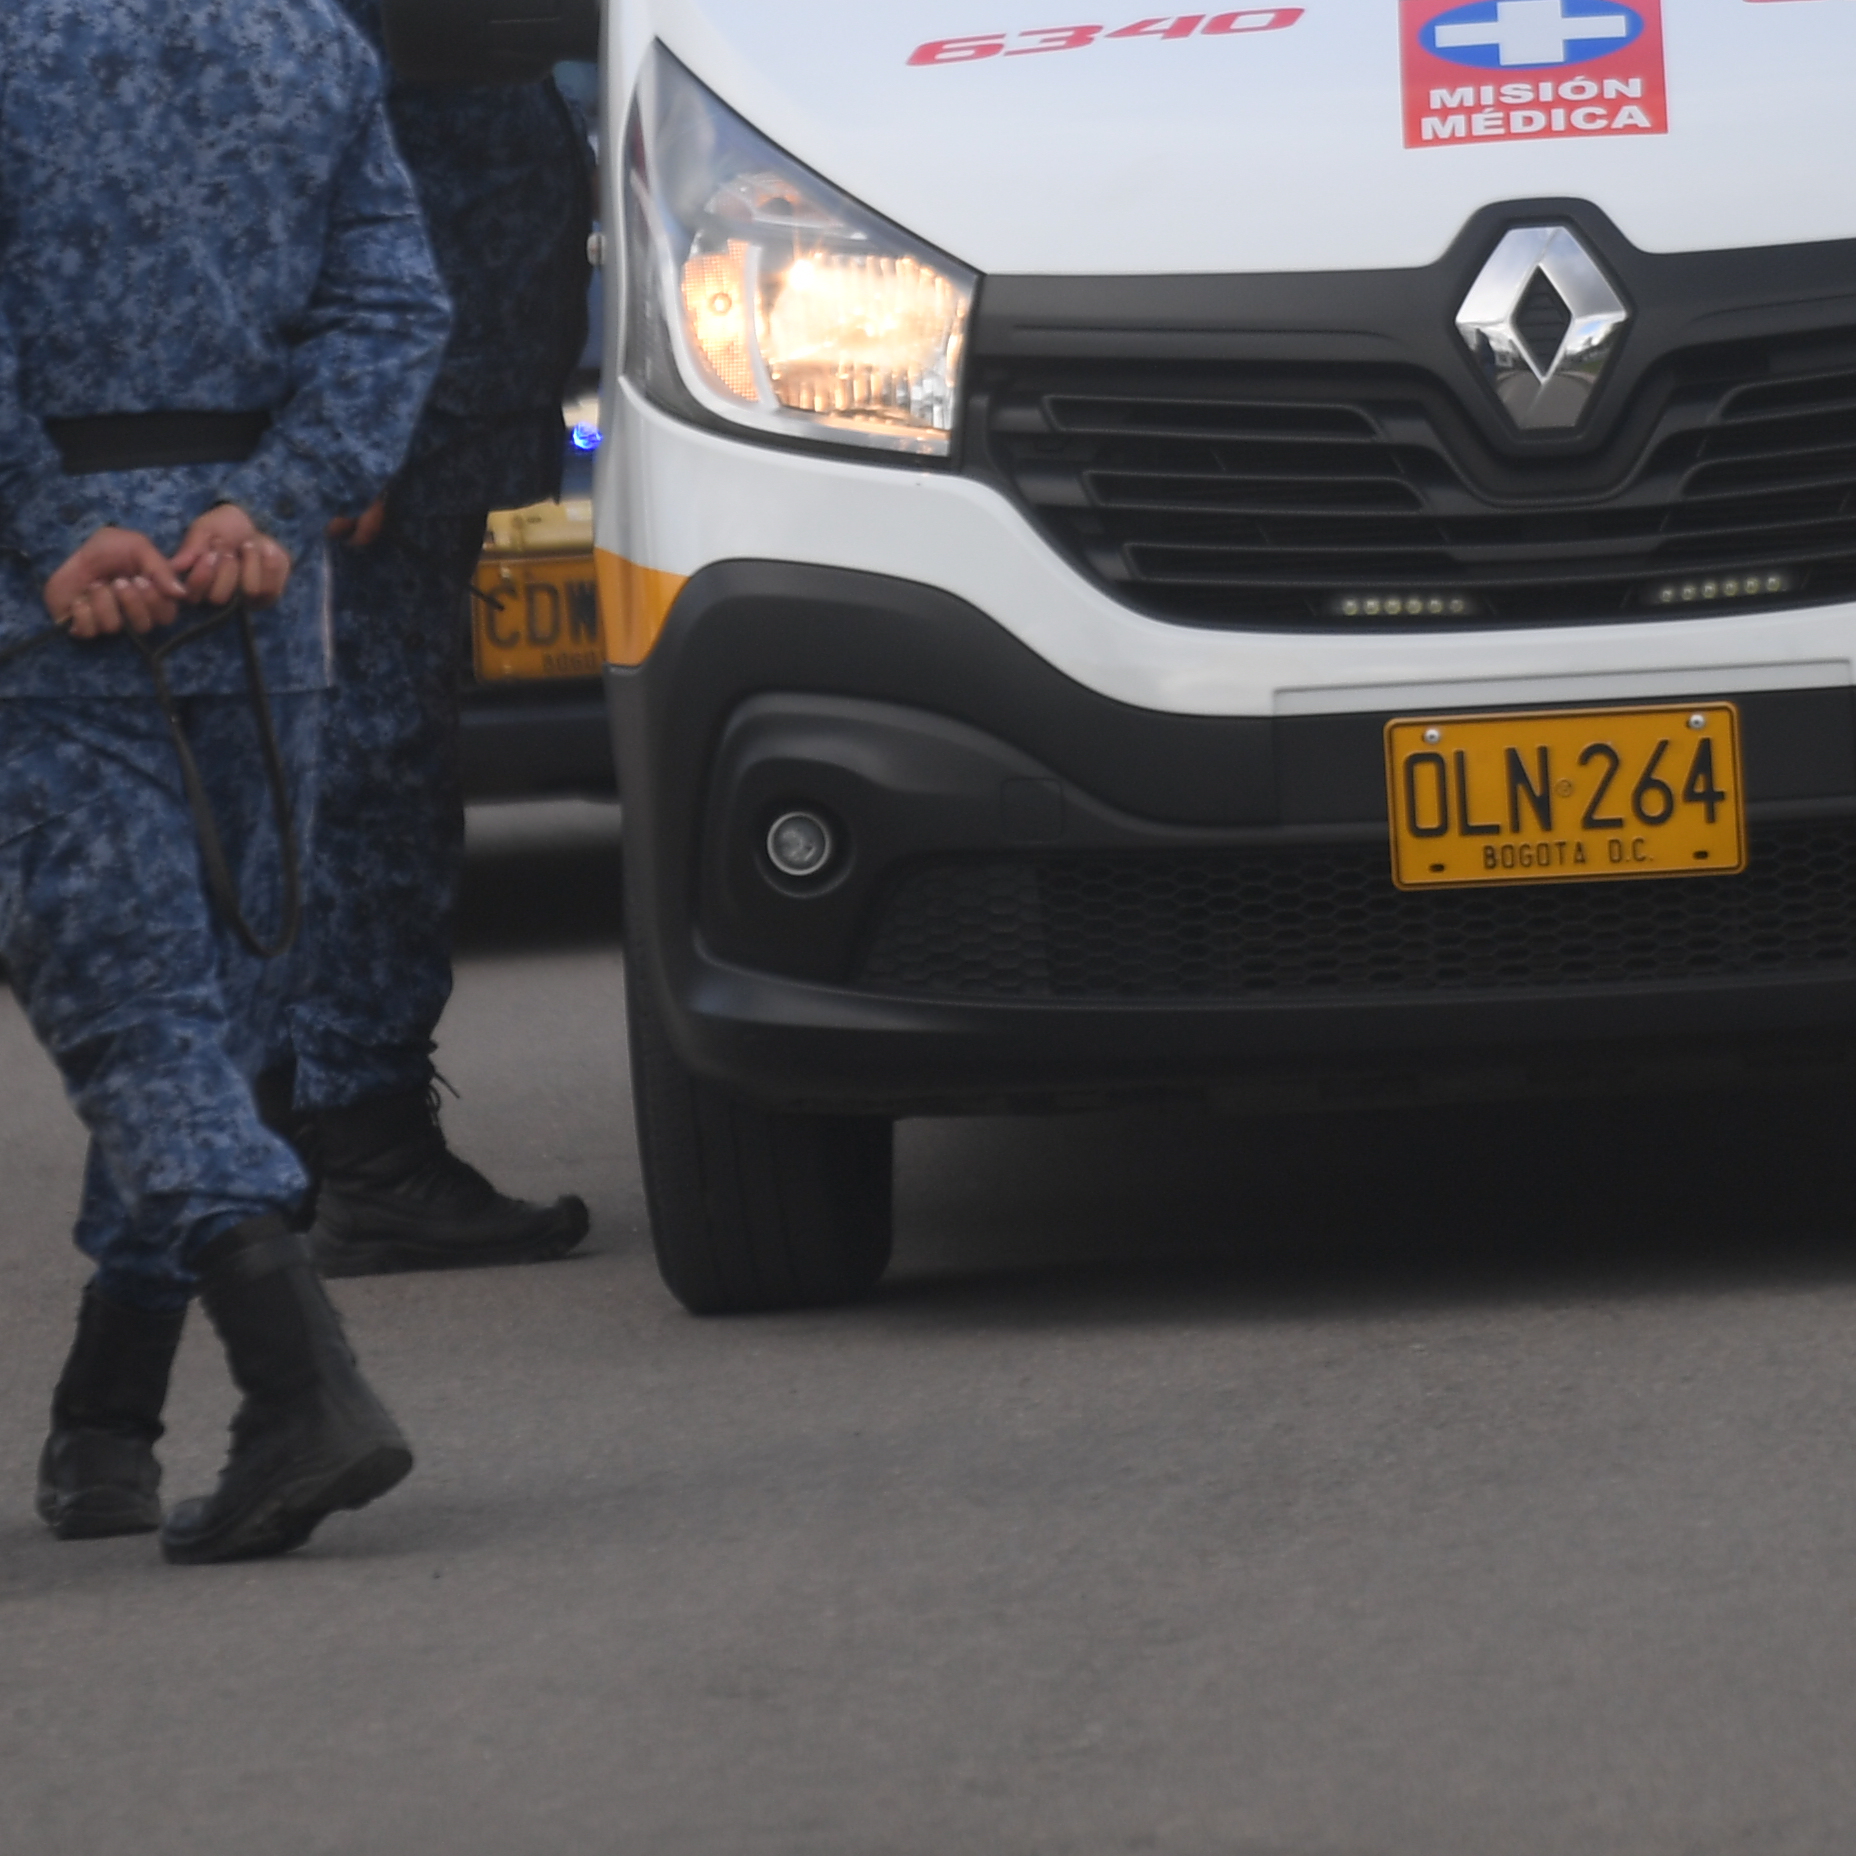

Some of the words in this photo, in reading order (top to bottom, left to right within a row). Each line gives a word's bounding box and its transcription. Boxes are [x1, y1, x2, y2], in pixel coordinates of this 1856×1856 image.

[905, 6, 1307, 67] 6340
[1428, 75, 1643, 110] MISIÓN
[1420, 105, 1652, 141] MÉDICA
[1483, 841, 1588, 871] BOGOTA
